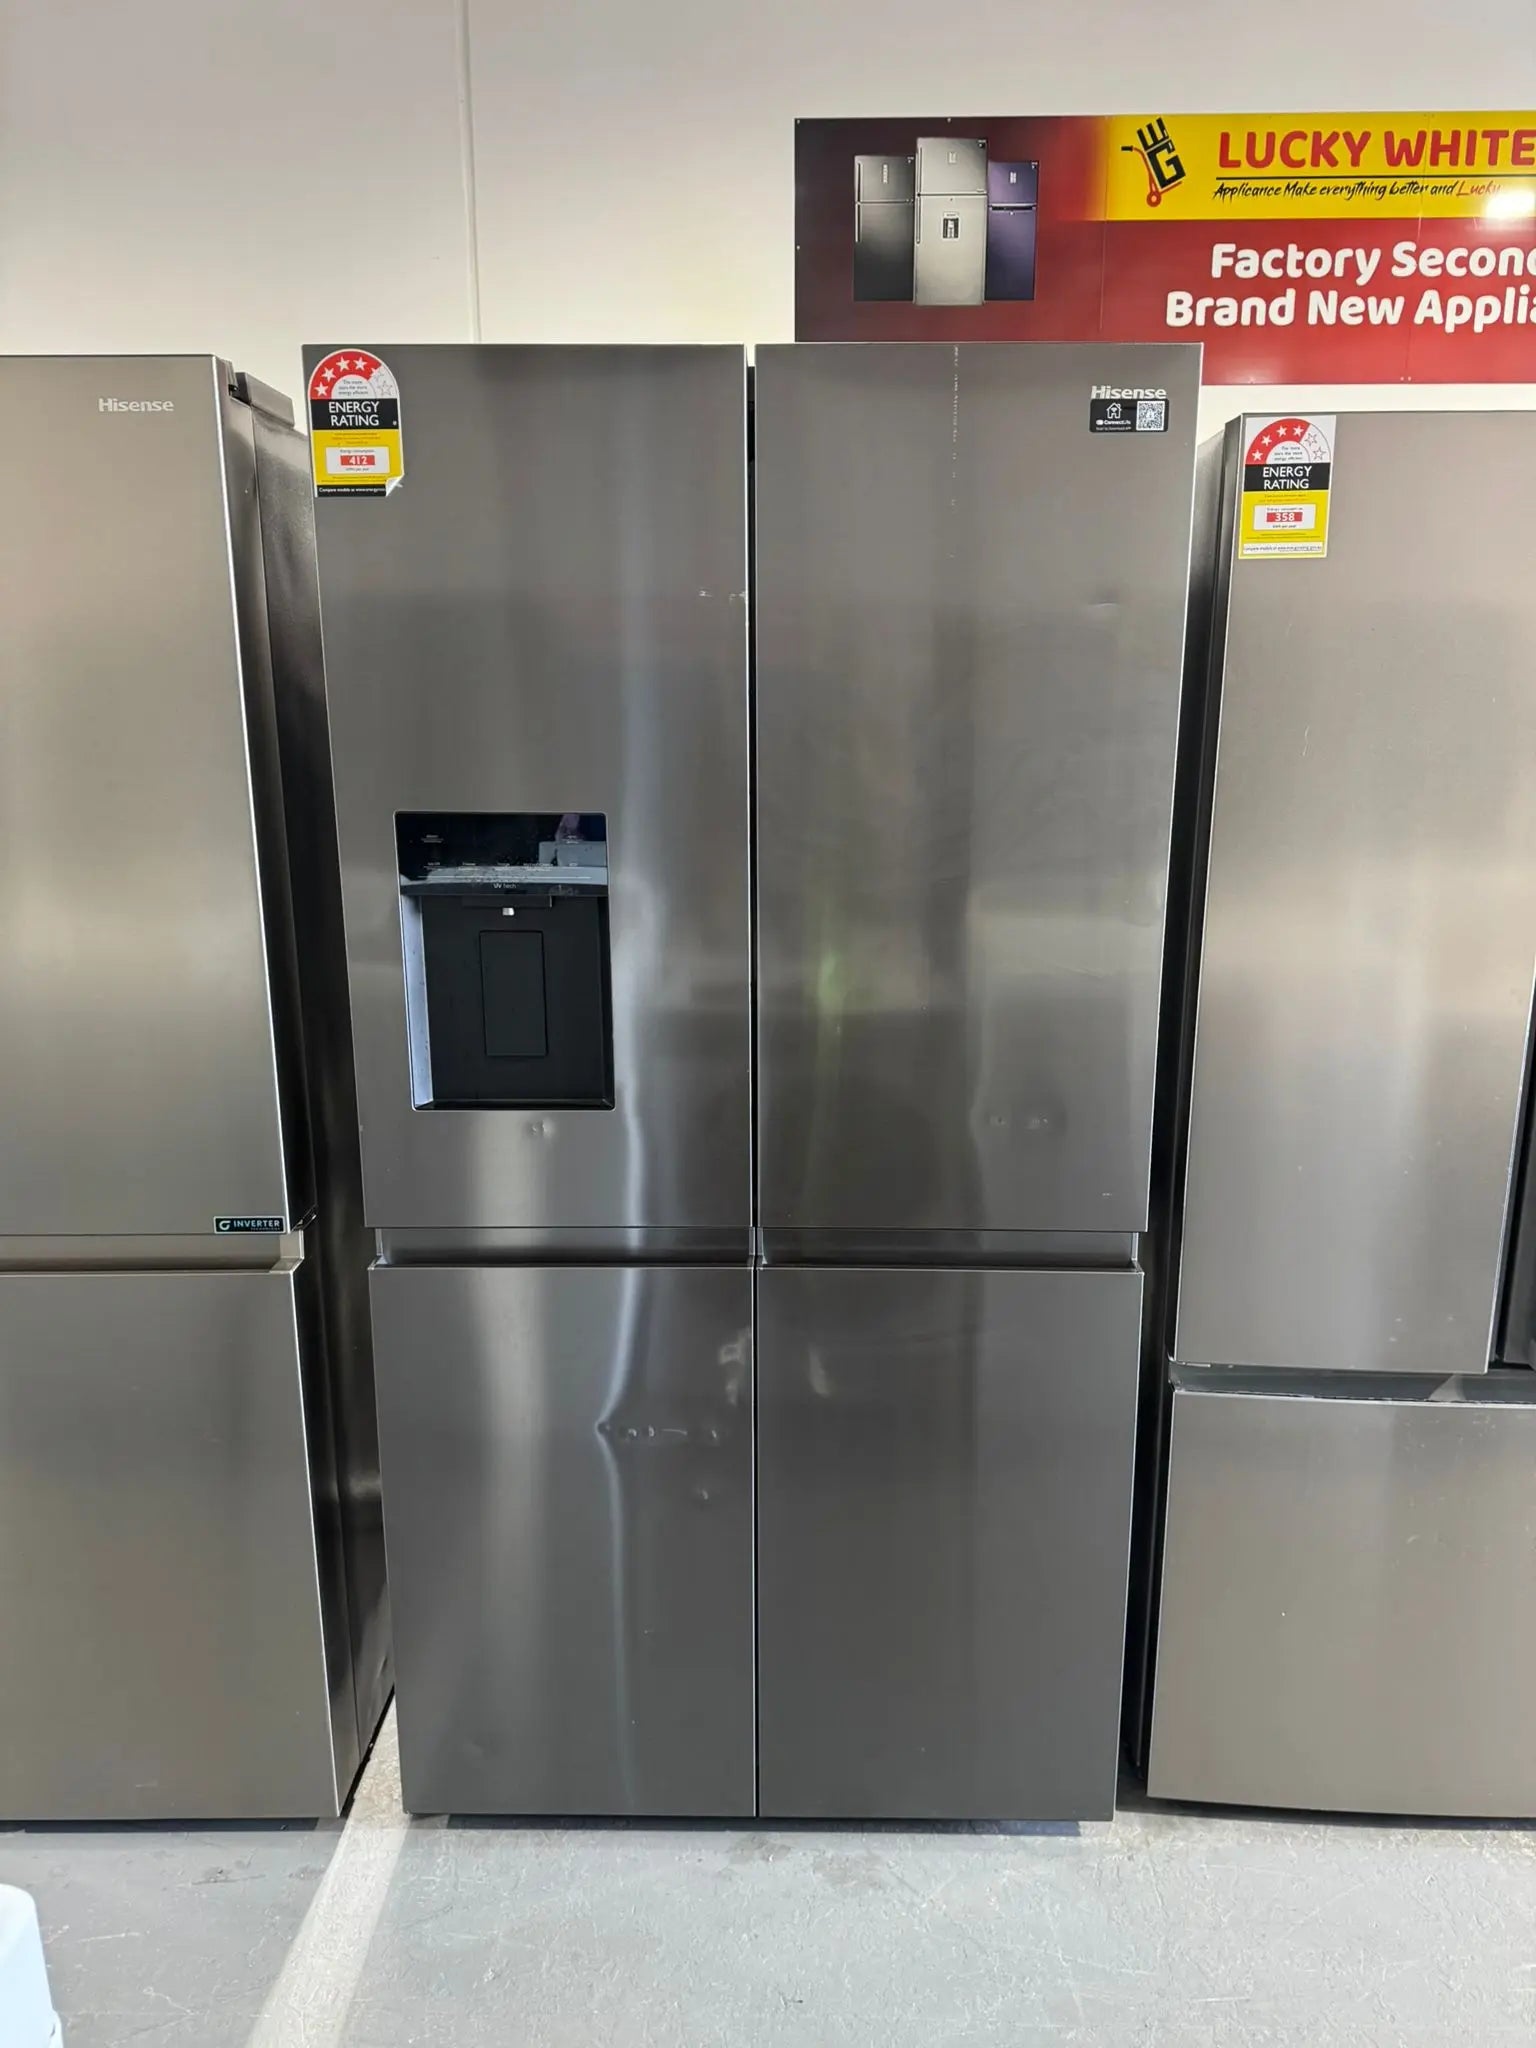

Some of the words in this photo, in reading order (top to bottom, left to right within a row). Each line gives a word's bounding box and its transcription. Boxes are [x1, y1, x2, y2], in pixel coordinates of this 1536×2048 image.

[1218, 130, 1372, 169] LUCKY
[1384, 129, 1536, 168] WHITE
[1283, 181, 1317, 198] Make
[1319, 181, 1387, 200] everything
[1389, 181, 1428, 196] better
[1430, 180, 1458, 195] and
[1211, 243, 1382, 286] Factory
[1165, 288, 1297, 328] Brand
[1307, 290, 1406, 326] New
[1091, 385, 1167, 400] Hisense
[98, 398, 175, 412] Hisense
[328, 401, 380, 413] ENERGY
[330, 414, 380, 427] RATING
[348, 455, 368, 465] 412
[1262, 465, 1313, 478] ENERGY
[1263, 479, 1310, 490] RATING
[1274, 512, 1296, 522] 358
[233, 1220, 280, 1228] INVERTER
